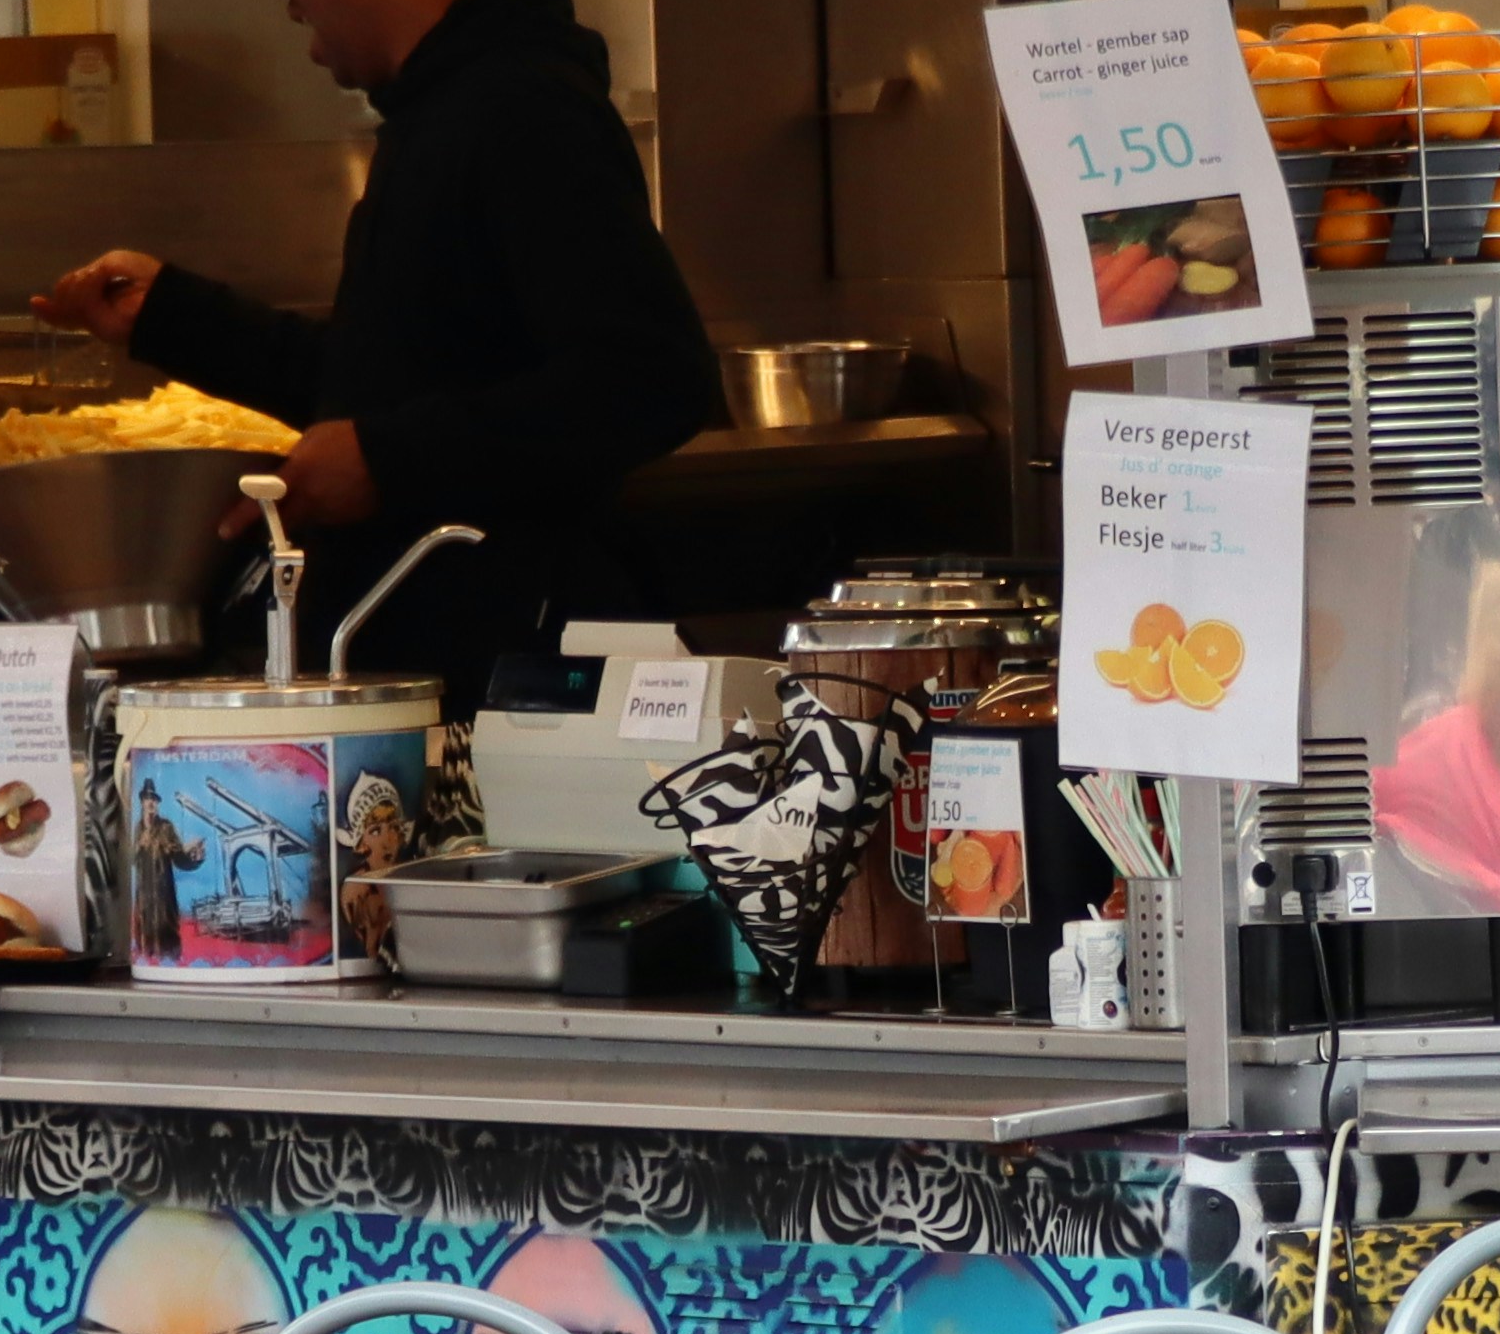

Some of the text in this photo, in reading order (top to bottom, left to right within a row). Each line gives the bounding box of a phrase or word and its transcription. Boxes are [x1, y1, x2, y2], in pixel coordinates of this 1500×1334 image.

[1026, 37, 1083, 59] Wortel
[1095, 31, 1157, 55] gember
[1161, 27, 1190, 45] sap
[1032, 66, 1084, 85] Carrot
[1096, 58, 1147, 81] ginger
[1150, 53, 1190, 74] juice
[1066, 121, 1196, 187] 1,50
[1104, 419, 1252, 452] Vers geperst
[1166, 461, 1223, 481] orange
[1100, 484, 1168, 510] Beker
[1182, 490, 1193, 513] 1
[1099, 522, 1165, 554] Flesje
[1210, 530, 1223, 554] 3
[629, 696, 688, 718] Pinnen
[930, 800, 962, 825] 1,50
